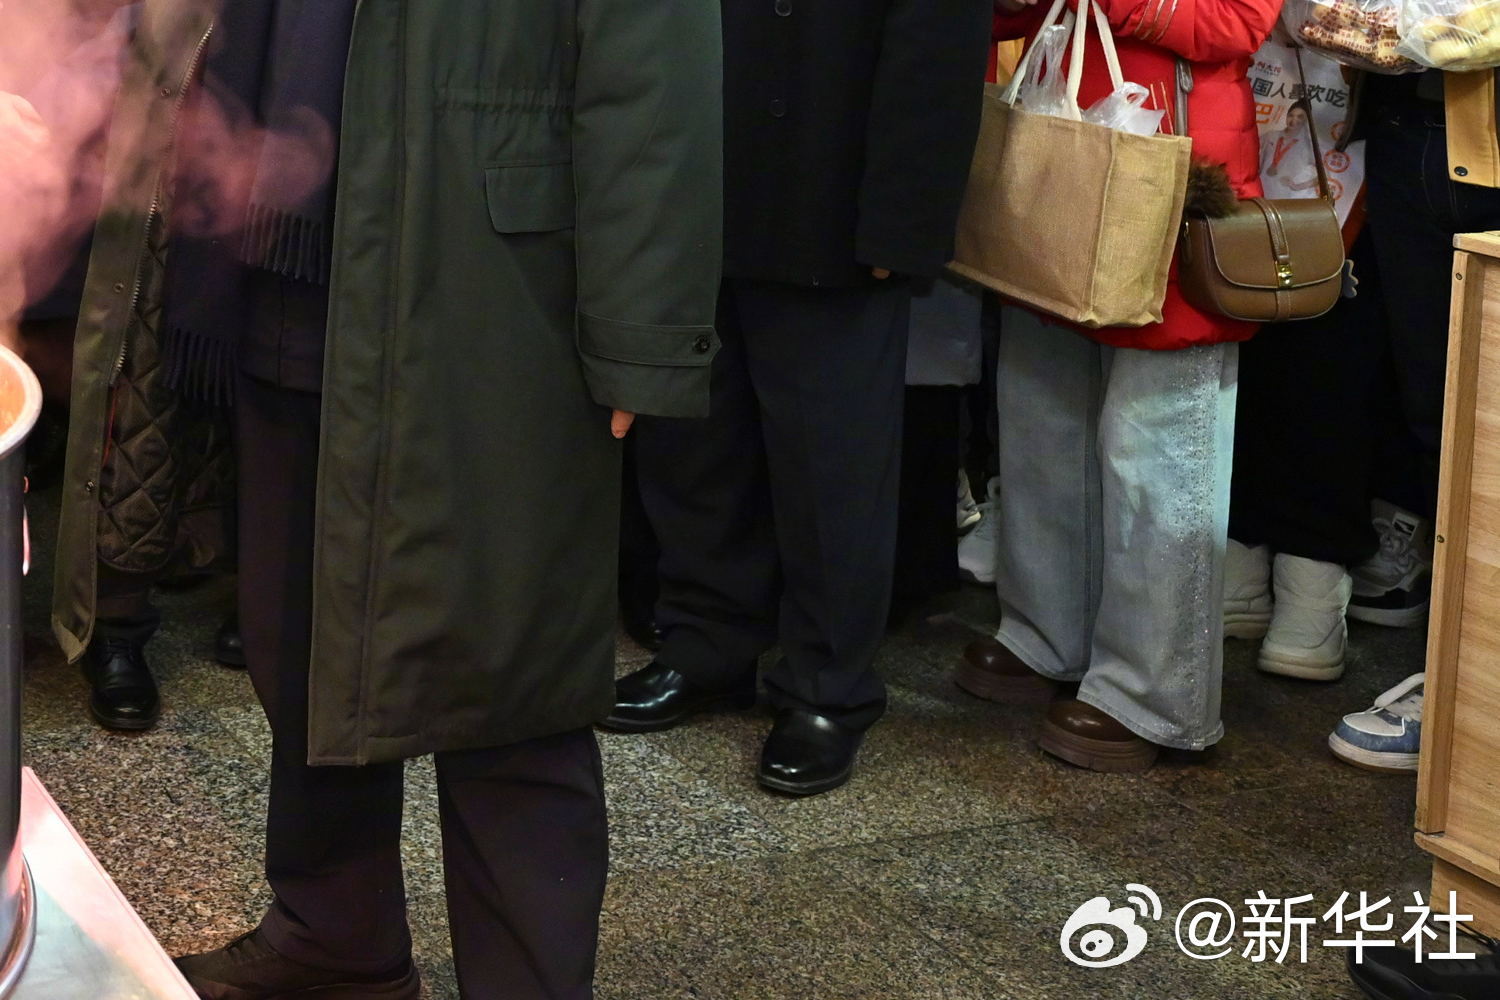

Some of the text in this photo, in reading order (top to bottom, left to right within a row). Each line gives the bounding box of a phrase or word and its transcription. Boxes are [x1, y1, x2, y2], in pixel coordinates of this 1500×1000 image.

[1250, 77, 1349, 108] 国人喜欢吃
